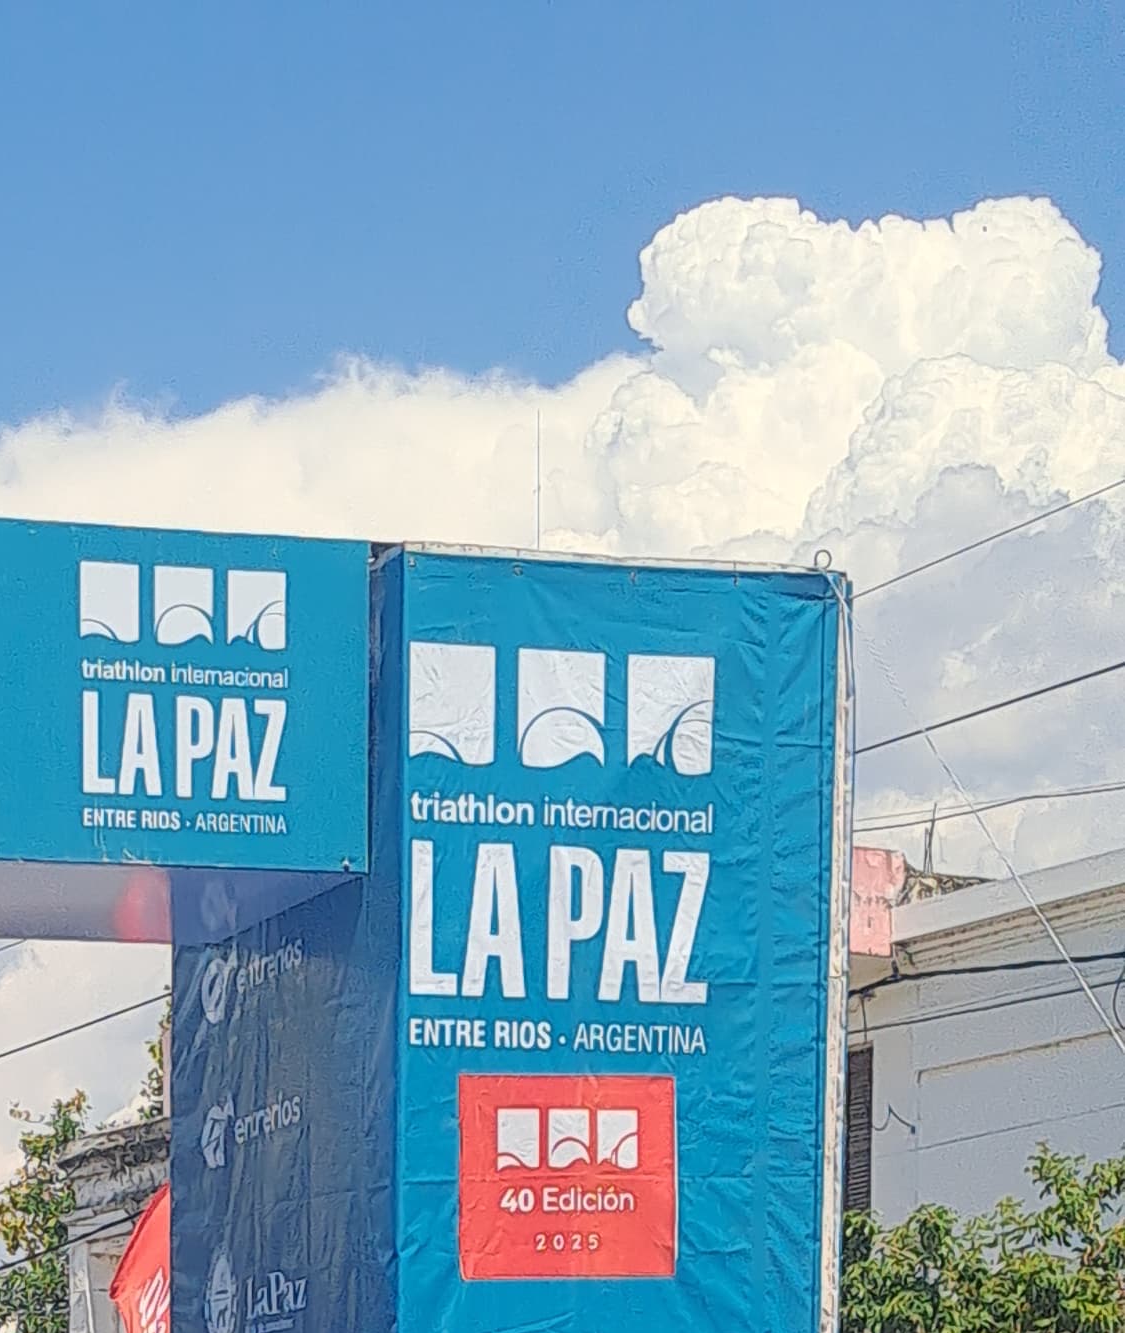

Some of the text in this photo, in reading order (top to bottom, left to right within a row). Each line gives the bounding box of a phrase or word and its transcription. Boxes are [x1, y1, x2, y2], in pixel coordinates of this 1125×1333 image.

[81, 658, 288, 689] triathlon internacional
[82, 690, 287, 803] LA PAZ
[82, 807, 288, 835] ENTRE RIOS ARGENTINA
[410, 794, 714, 834] triathlon internacional
[409, 839, 710, 1004] LA PAZ
[409, 1018, 707, 1056] ENTRE RIOS ARGENTINA
[500, 1185, 636, 1214] 40 Edición
[535, 1231, 601, 1253] 2025
